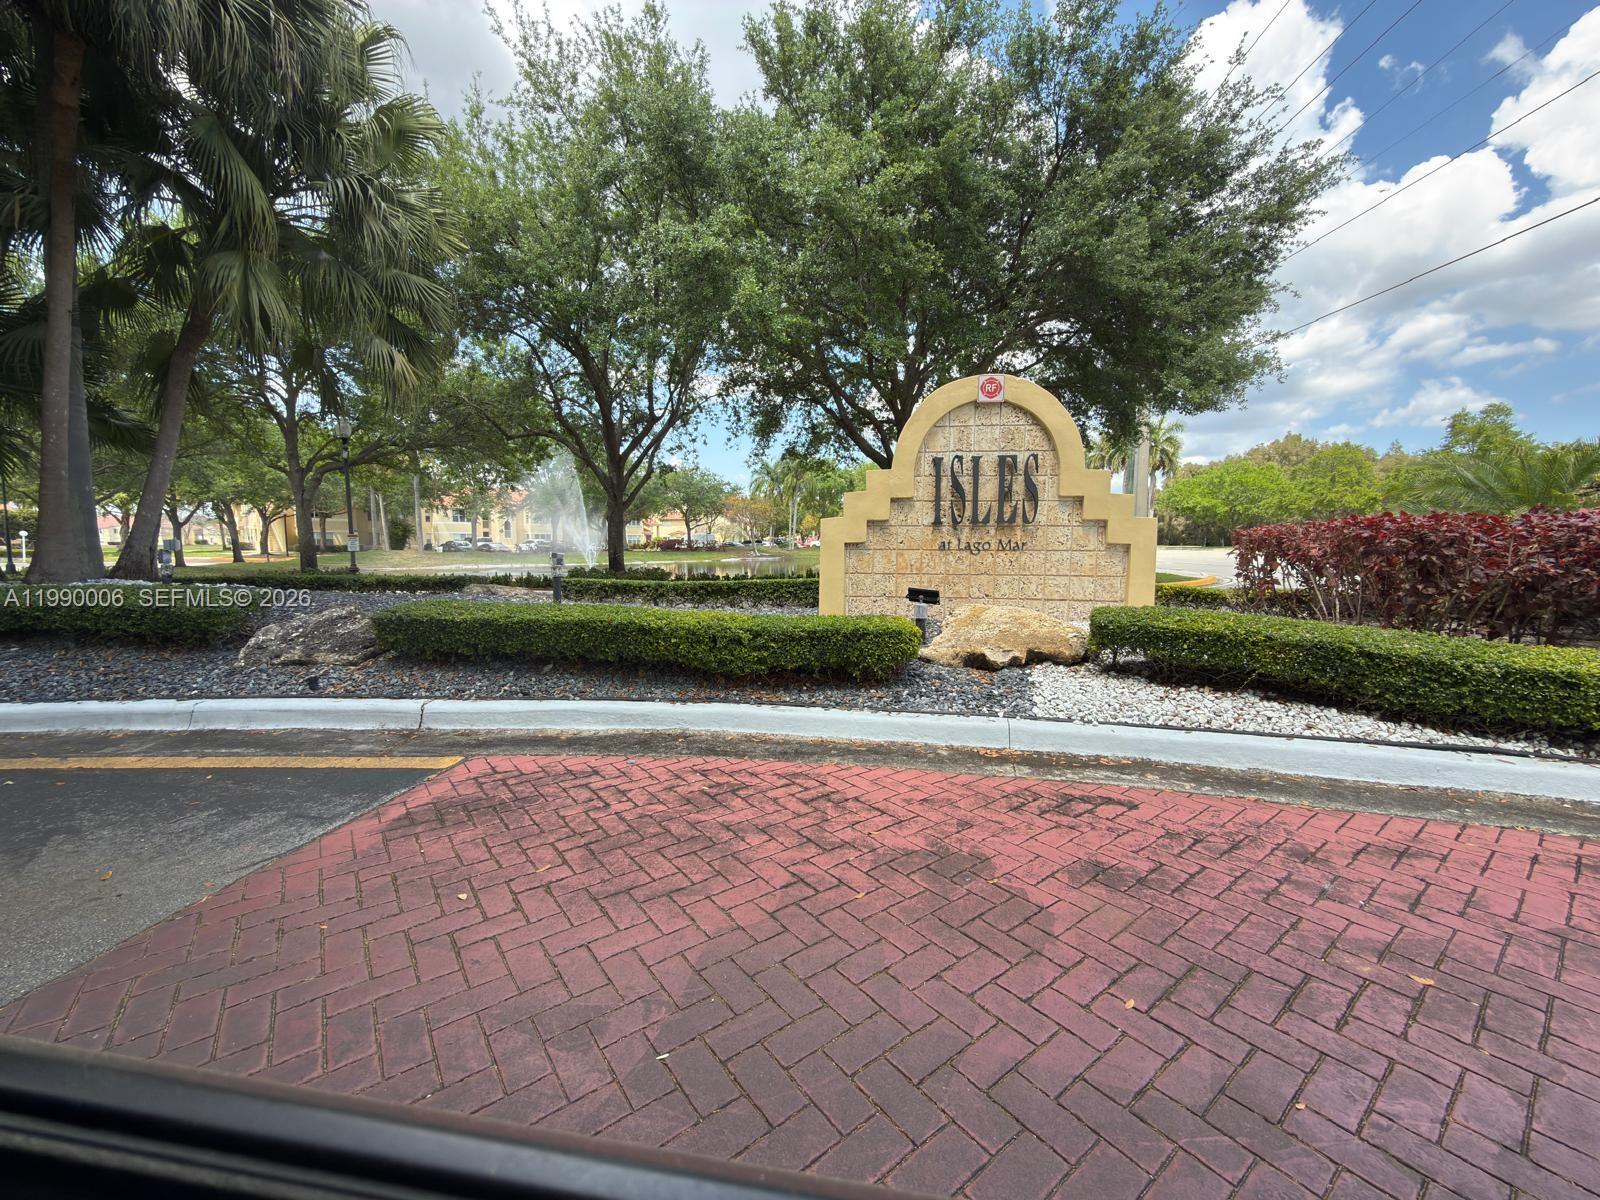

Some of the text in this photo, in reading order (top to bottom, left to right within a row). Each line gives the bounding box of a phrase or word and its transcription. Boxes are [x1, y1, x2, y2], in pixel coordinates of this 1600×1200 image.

[985, 383, 997, 392] RF
[932, 454, 1039, 526] ISLES
[938, 538, 1027, 555] at Lago Mar
